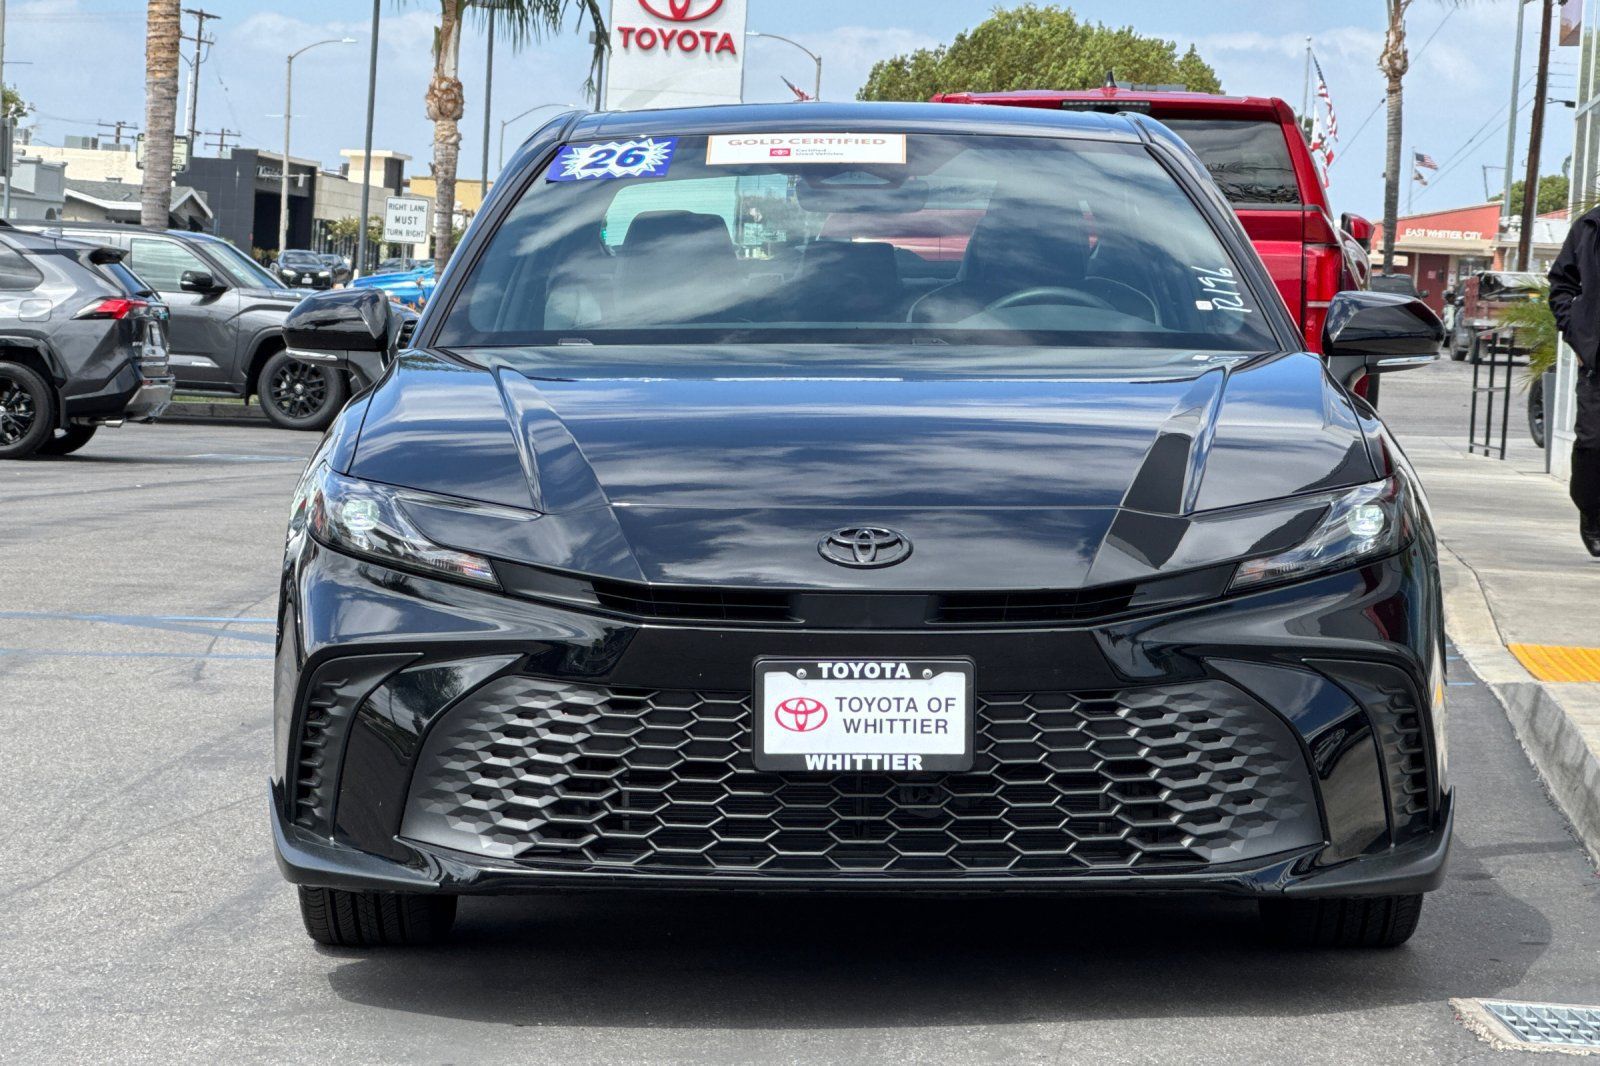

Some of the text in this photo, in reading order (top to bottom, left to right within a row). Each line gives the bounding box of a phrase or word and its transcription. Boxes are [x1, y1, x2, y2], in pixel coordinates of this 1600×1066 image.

[617, 26, 737, 55] TOYOTA
[788, 137, 887, 145] CERTIFIED
[580, 146, 650, 169] 26
[388, 203, 407, 211] RIGHT
[395, 215, 418, 225] MUST
[387, 228, 424, 238] TURN RIGHT
[1405, 228, 1482, 241] EAST WHITTIER CITY
[817, 662, 911, 679] TOYOTA
[834, 696, 956, 713] TOYOTA OF
[842, 718, 948, 734] WHITTIER
[805, 754, 923, 771] WHITTIER
